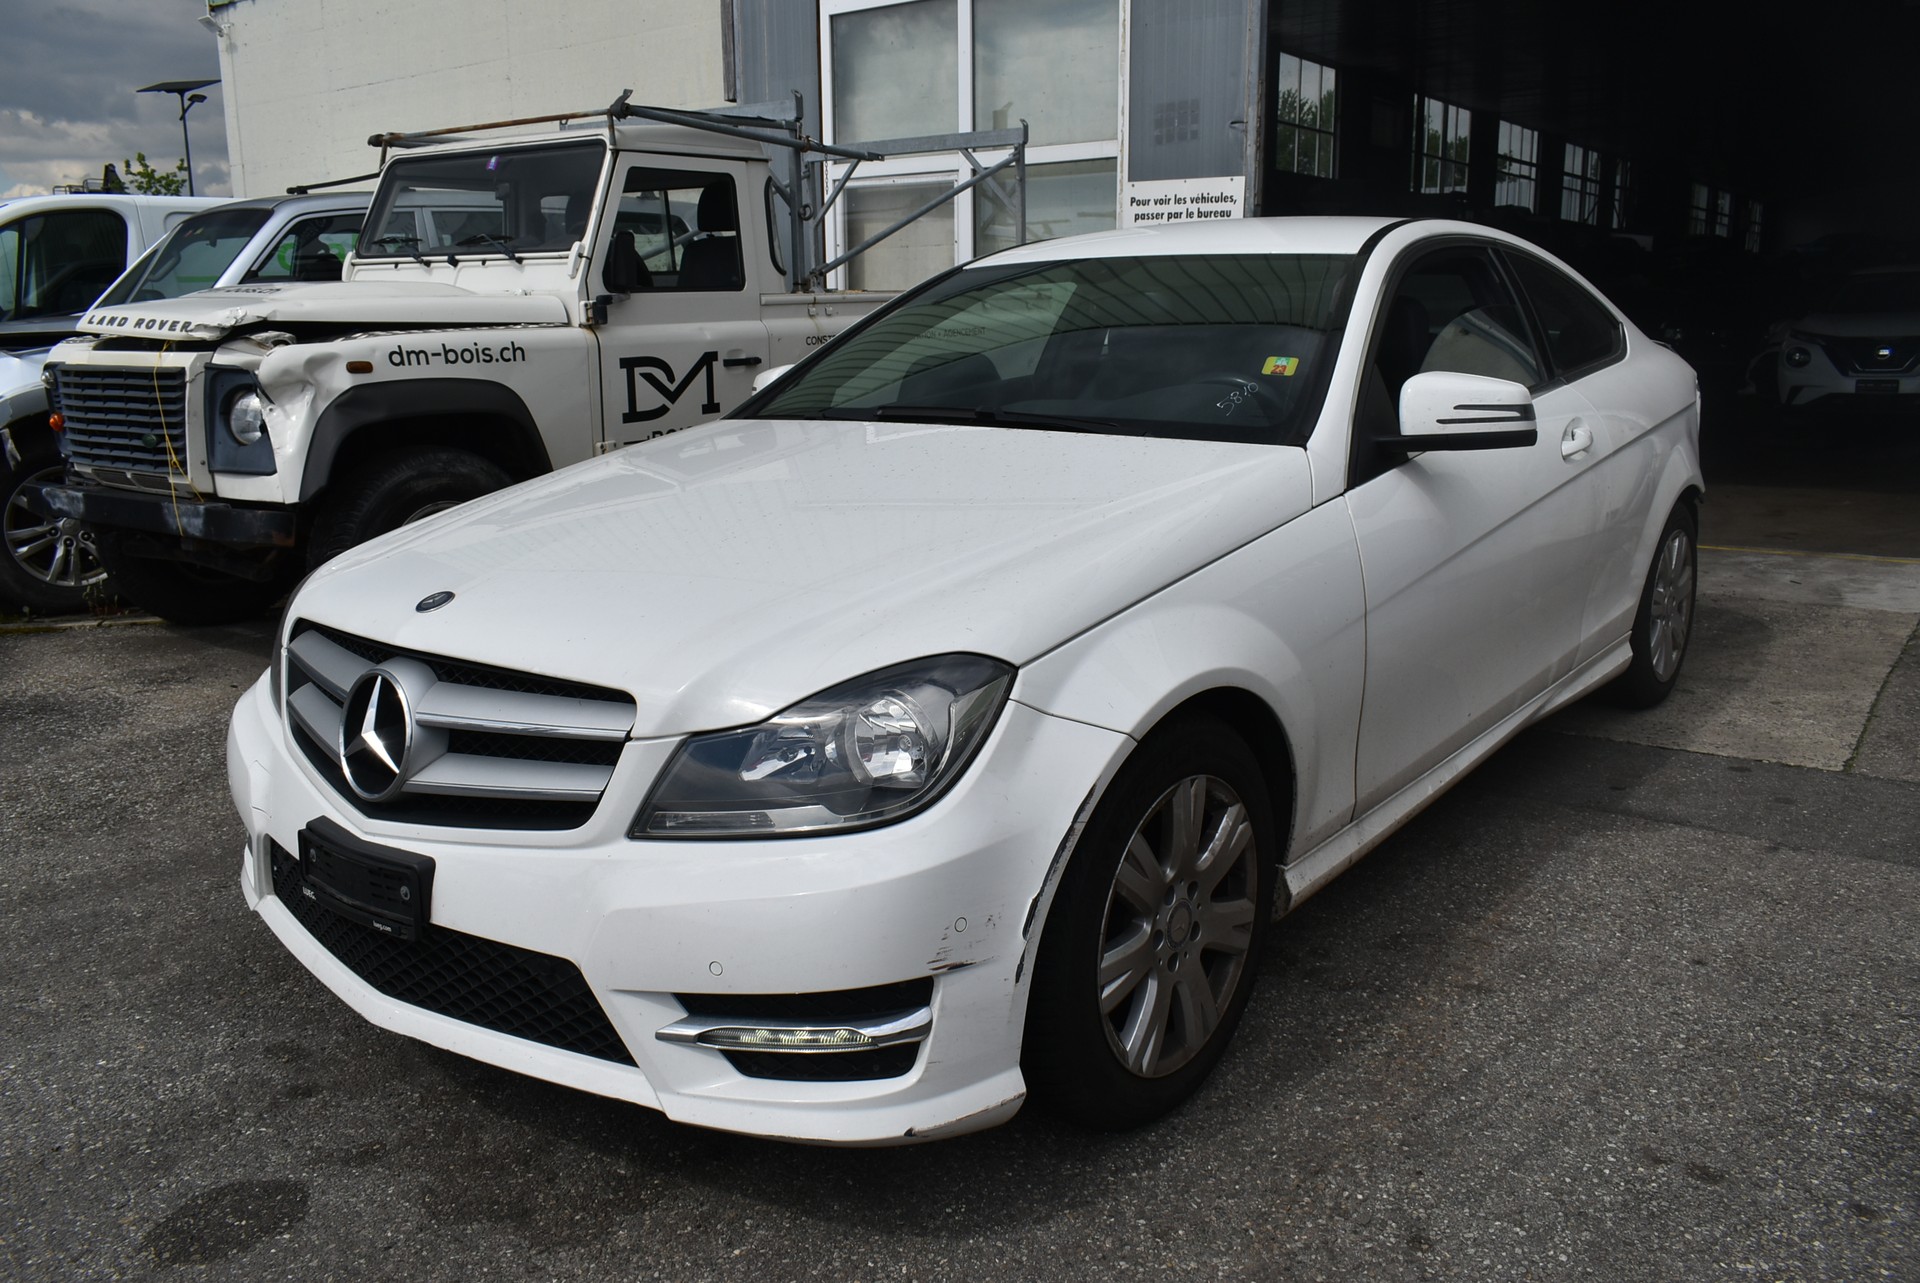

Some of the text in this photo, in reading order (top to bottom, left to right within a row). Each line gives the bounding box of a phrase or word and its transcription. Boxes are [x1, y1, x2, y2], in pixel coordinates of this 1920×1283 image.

[1130, 192, 1237, 207] Pour voir les véhicules,
[1134, 207, 1231, 223] passer par le bureau
[87, 314, 194, 333] LAND ROVER
[388, 341, 526, 367] dm-bois.ch
[619, 351, 720, 424] DM
